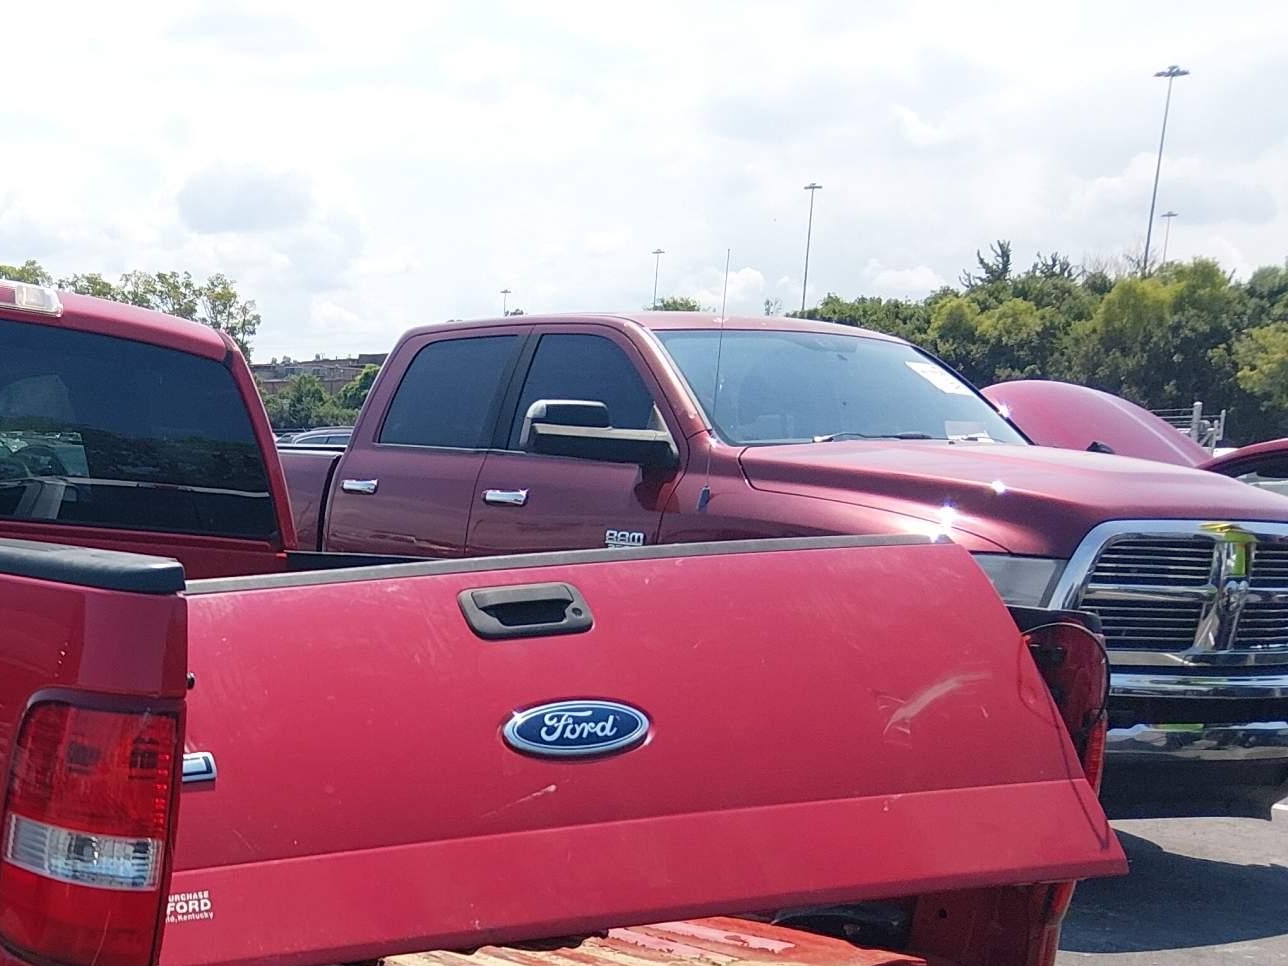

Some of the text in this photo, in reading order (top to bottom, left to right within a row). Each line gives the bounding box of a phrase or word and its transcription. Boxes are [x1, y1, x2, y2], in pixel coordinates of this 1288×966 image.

[605, 530, 644, 546] RAM
[540, 710, 618, 742] Ford
[168, 891, 209, 902] URCHASE
[166, 899, 211, 915] FORD
